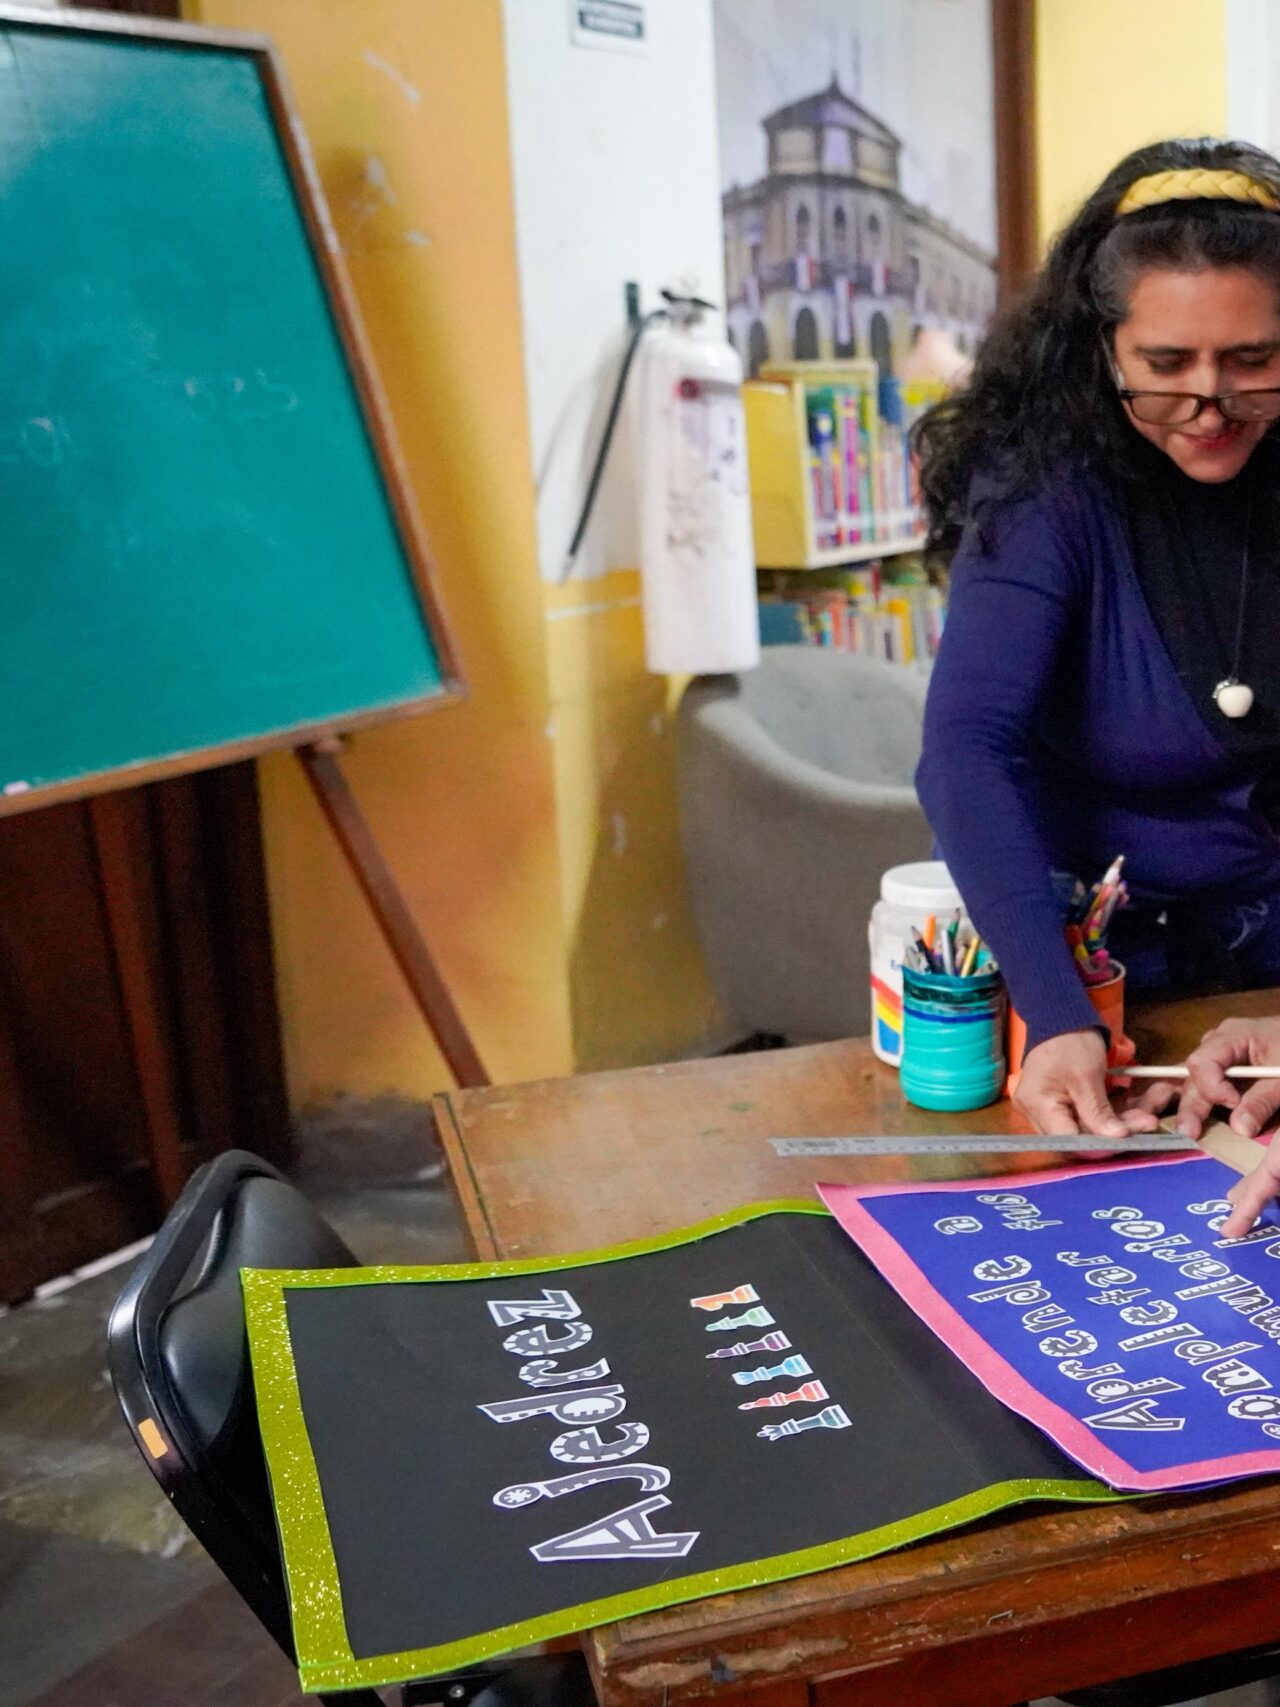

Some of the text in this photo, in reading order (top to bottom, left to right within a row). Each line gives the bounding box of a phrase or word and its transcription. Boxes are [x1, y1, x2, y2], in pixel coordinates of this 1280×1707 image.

[975, 1193, 1063, 1232] tus
[476, 1288, 701, 1563] Ajedrez
[932, 1215, 1186, 1432] Aprende a
